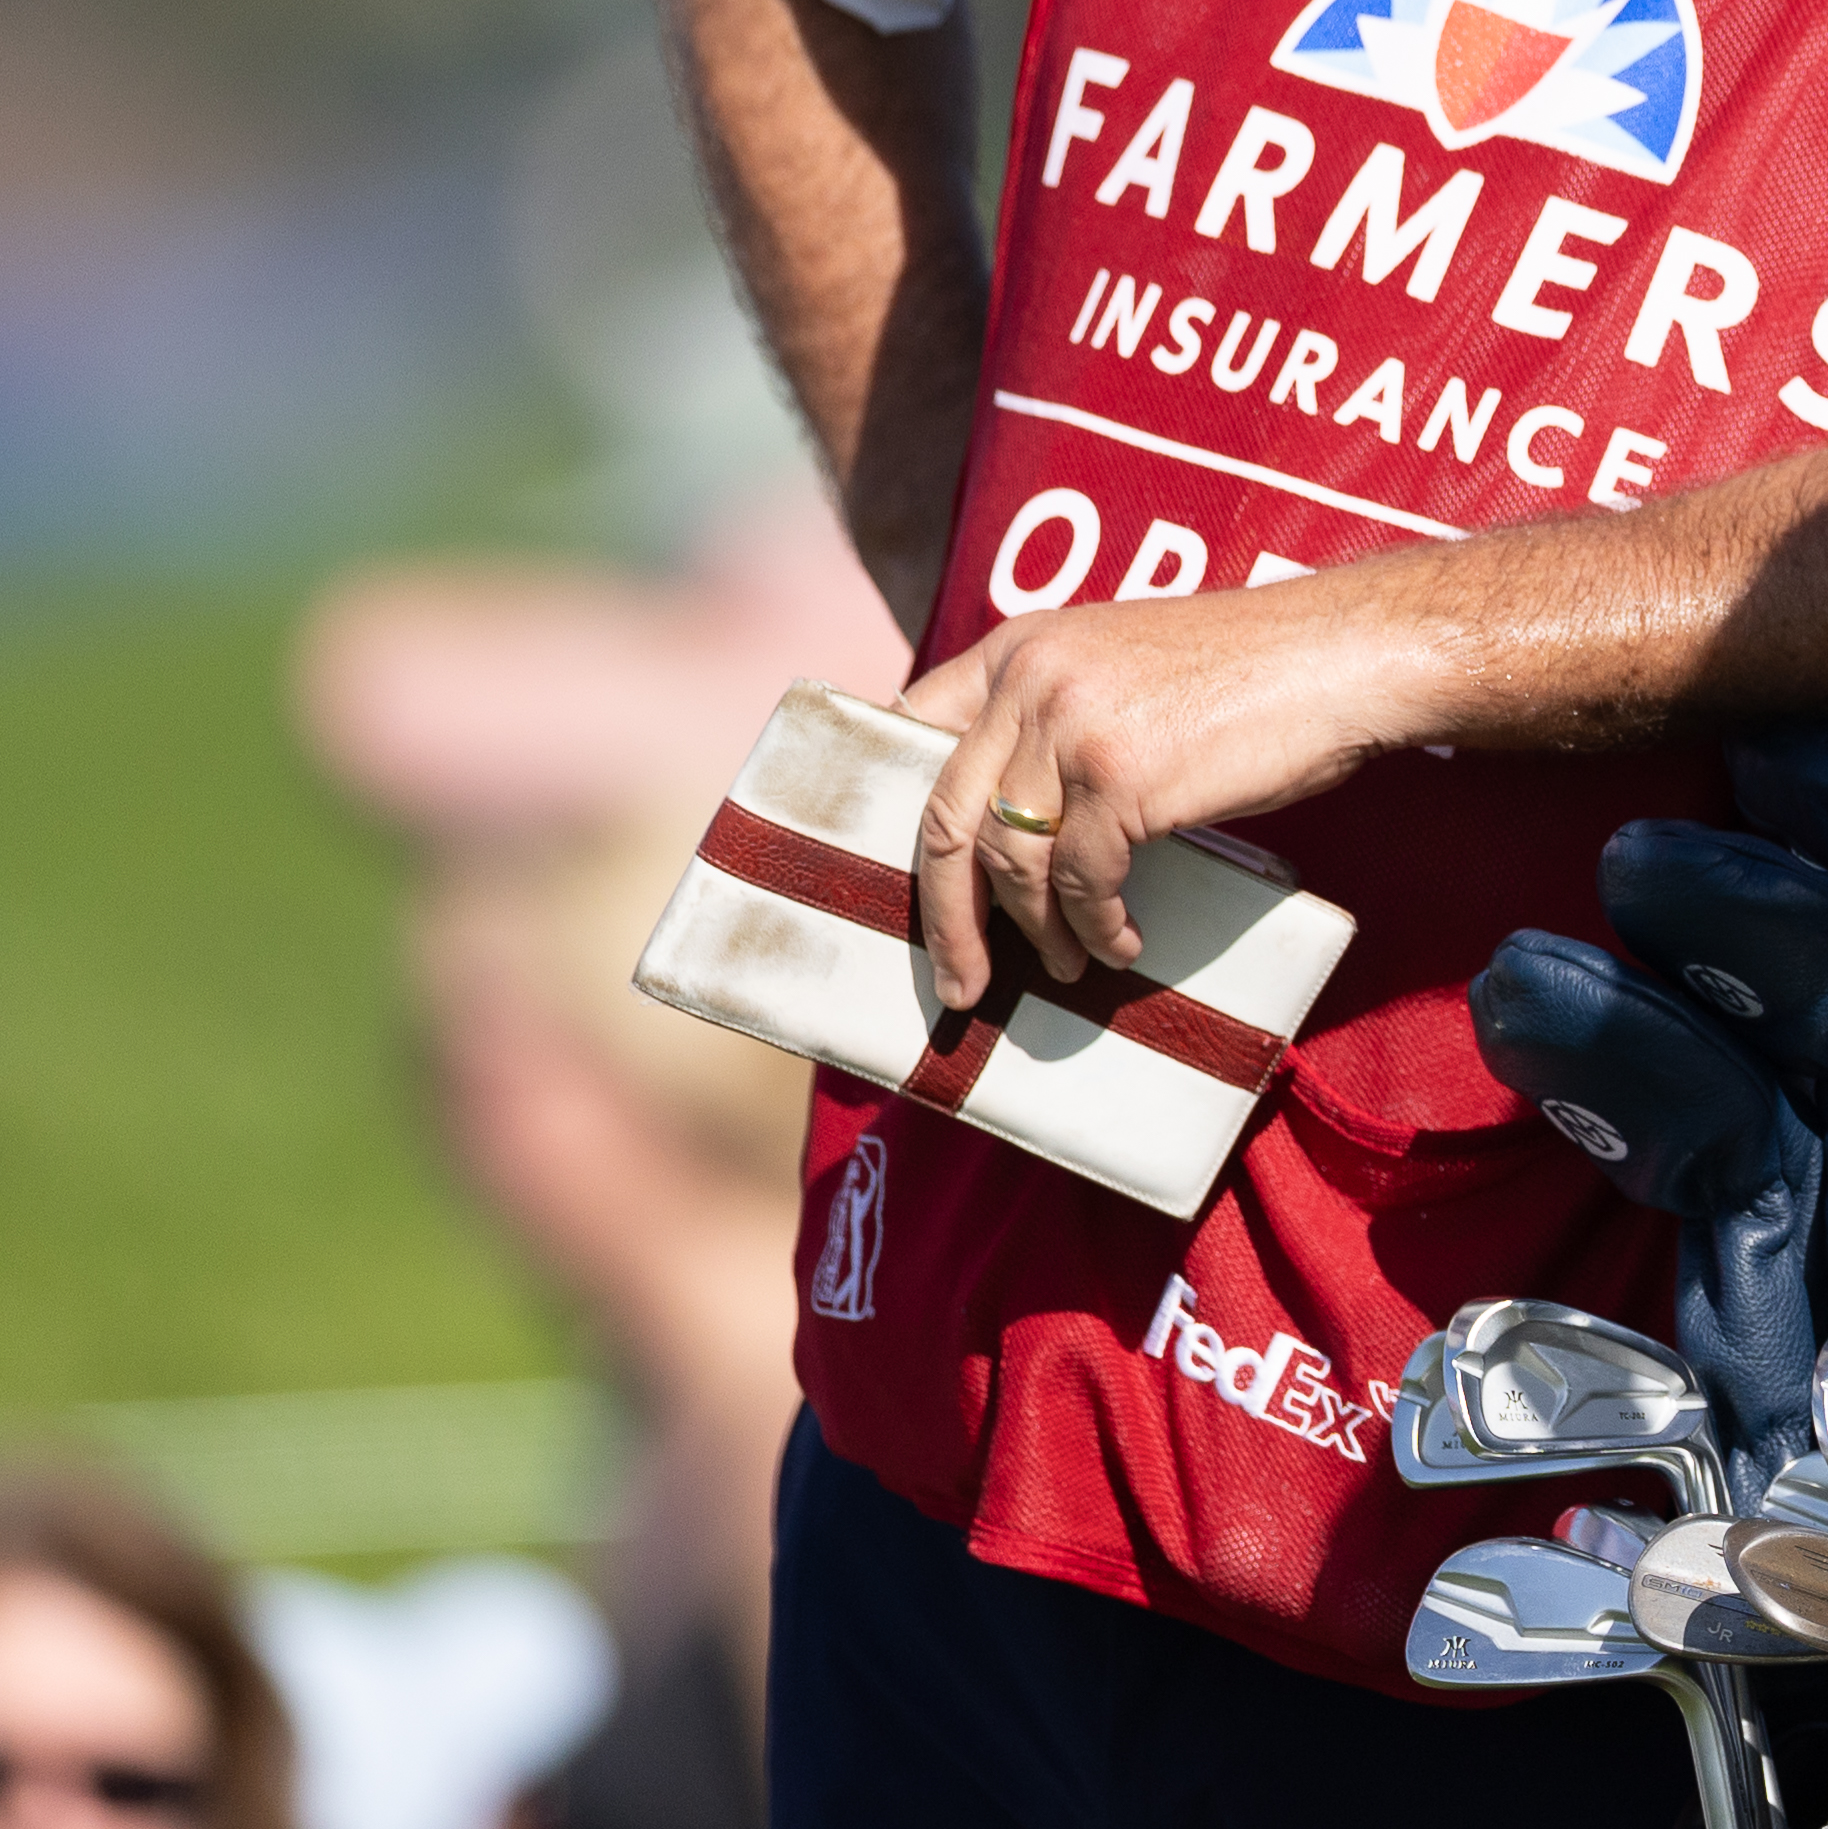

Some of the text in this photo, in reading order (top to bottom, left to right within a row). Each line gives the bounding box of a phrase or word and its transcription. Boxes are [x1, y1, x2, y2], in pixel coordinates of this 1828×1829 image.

[1069, 268, 1668, 510] INSURANCE
[1142, 1272, 1373, 1464] FedEx
[1498, 1412, 1540, 1423] MIURA
[1706, 1621, 1734, 1644] JR
